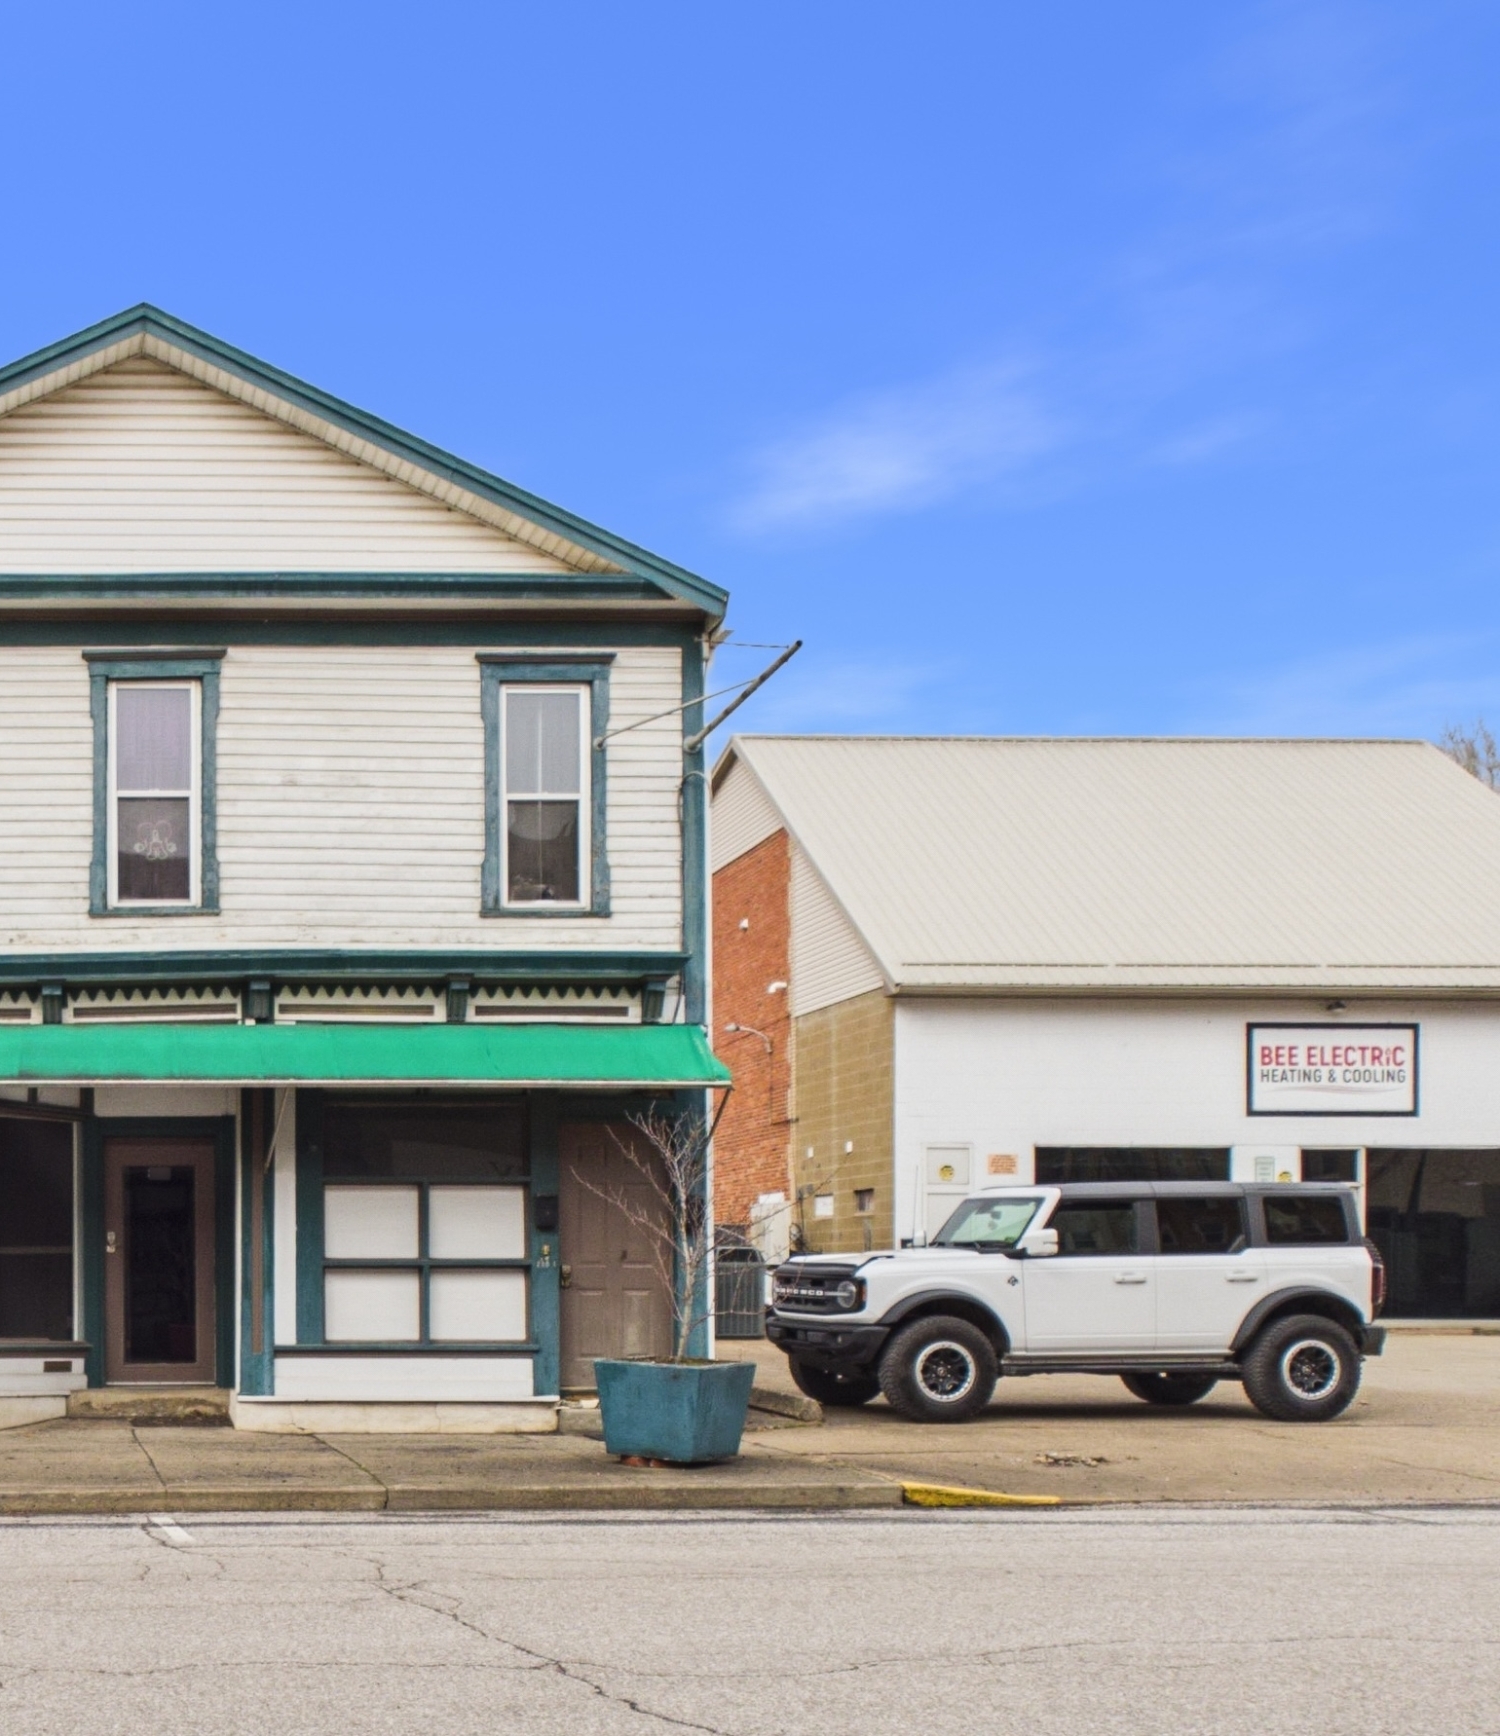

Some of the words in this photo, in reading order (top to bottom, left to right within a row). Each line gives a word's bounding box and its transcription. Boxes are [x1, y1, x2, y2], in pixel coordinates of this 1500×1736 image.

[1260, 1046, 1299, 1067] BEE
[1260, 1069, 1322, 1083] HEATING
[1327, 1069, 1338, 1083] &
[1342, 1069, 1406, 1083] COOLING
